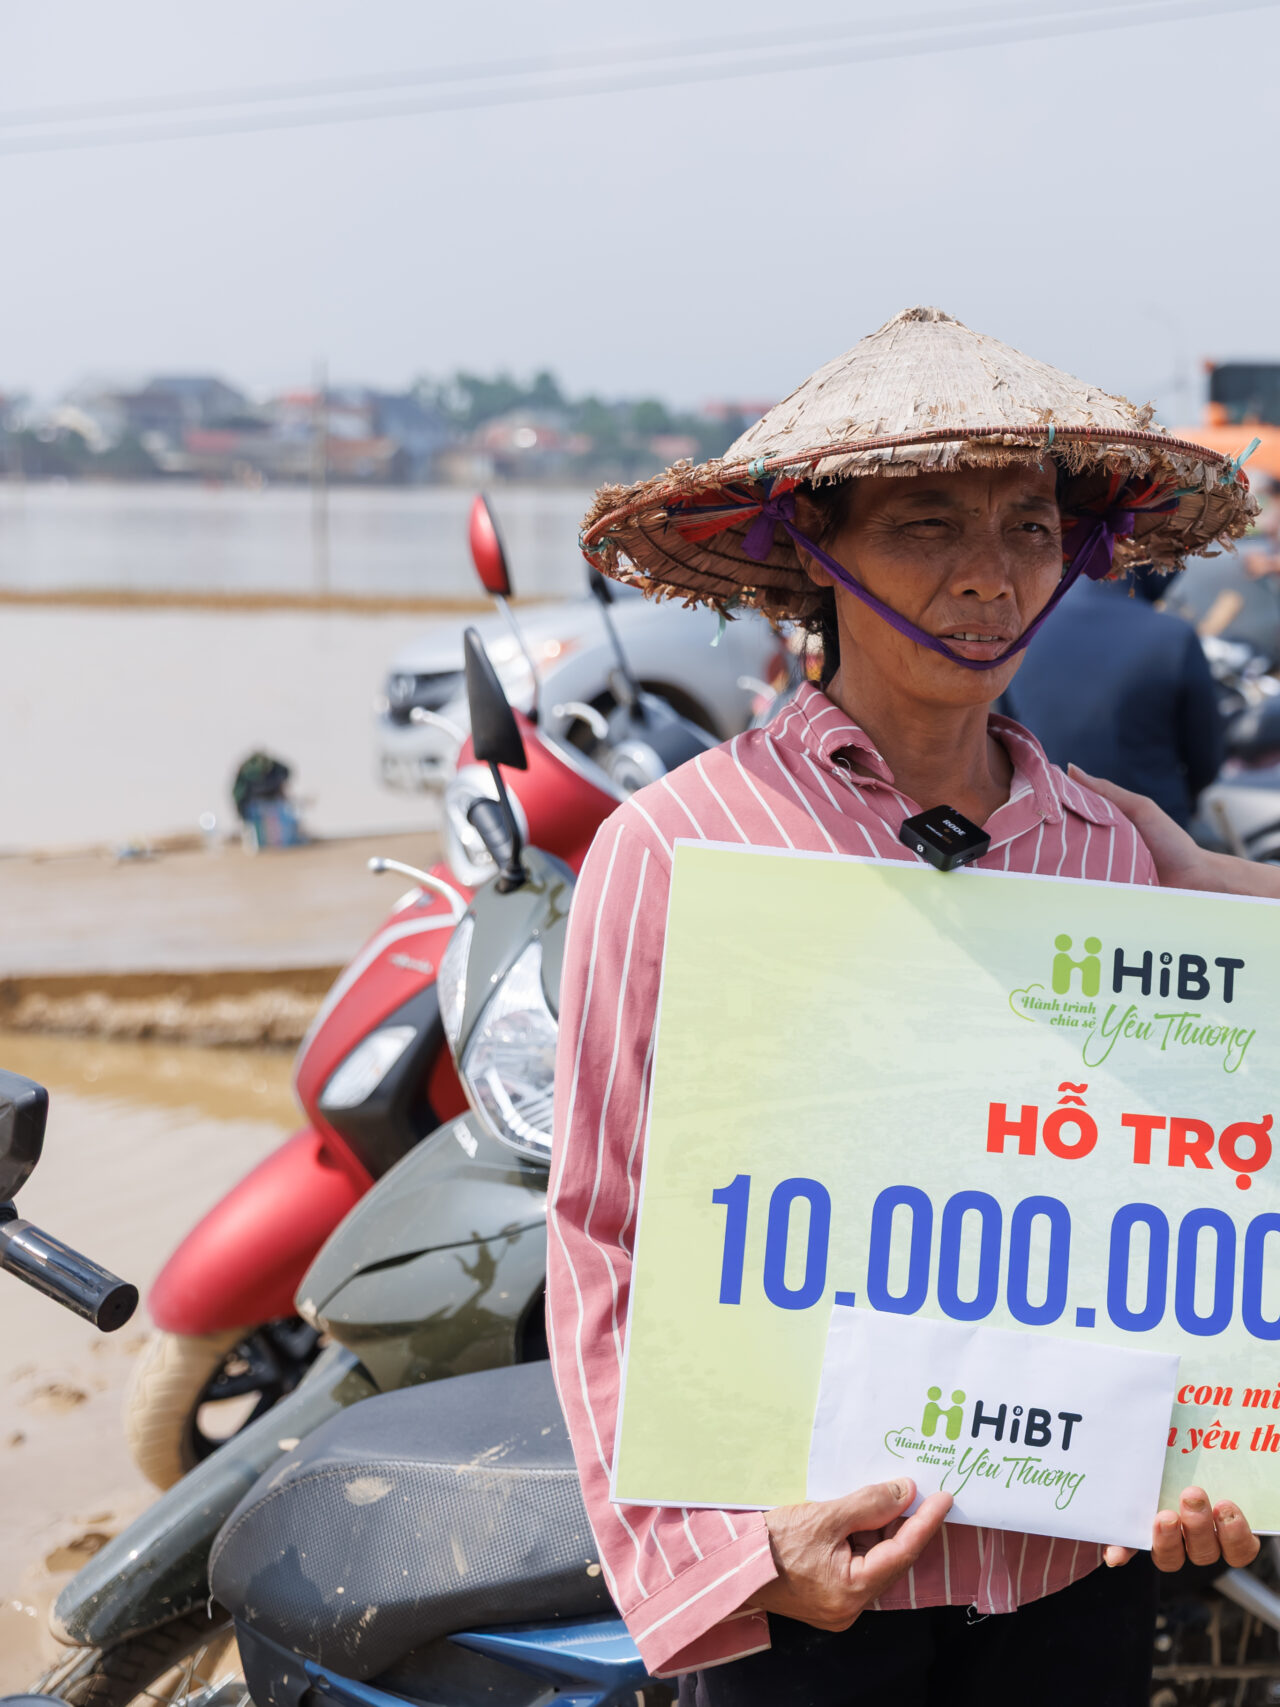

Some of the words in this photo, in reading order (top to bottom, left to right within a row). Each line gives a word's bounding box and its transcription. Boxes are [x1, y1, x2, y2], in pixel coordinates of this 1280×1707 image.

[1112, 947, 1245, 1004] HiBT
[1021, 995, 1060, 1012] Hành
[1063, 1000, 1097, 1014] trình
[1050, 1014, 1079, 1027] chia
[1083, 1004, 1154, 1067] Yêu
[1154, 1012, 1256, 1073] Thương
[986, 1081, 1098, 1160] HỖ
[1121, 1113, 1274, 1191] TRỢ
[1177, 1384, 1233, 1407] con
[971, 1400, 1083, 1451] HiBT
[1181, 1420, 1241, 1454] yêu
[894, 1436, 926, 1451] Hành
[928, 1442, 956, 1455] trình
[916, 1453, 941, 1466] chia
[939, 1446, 1002, 1496] Yêu
[1003, 1456, 1086, 1510] Thương
